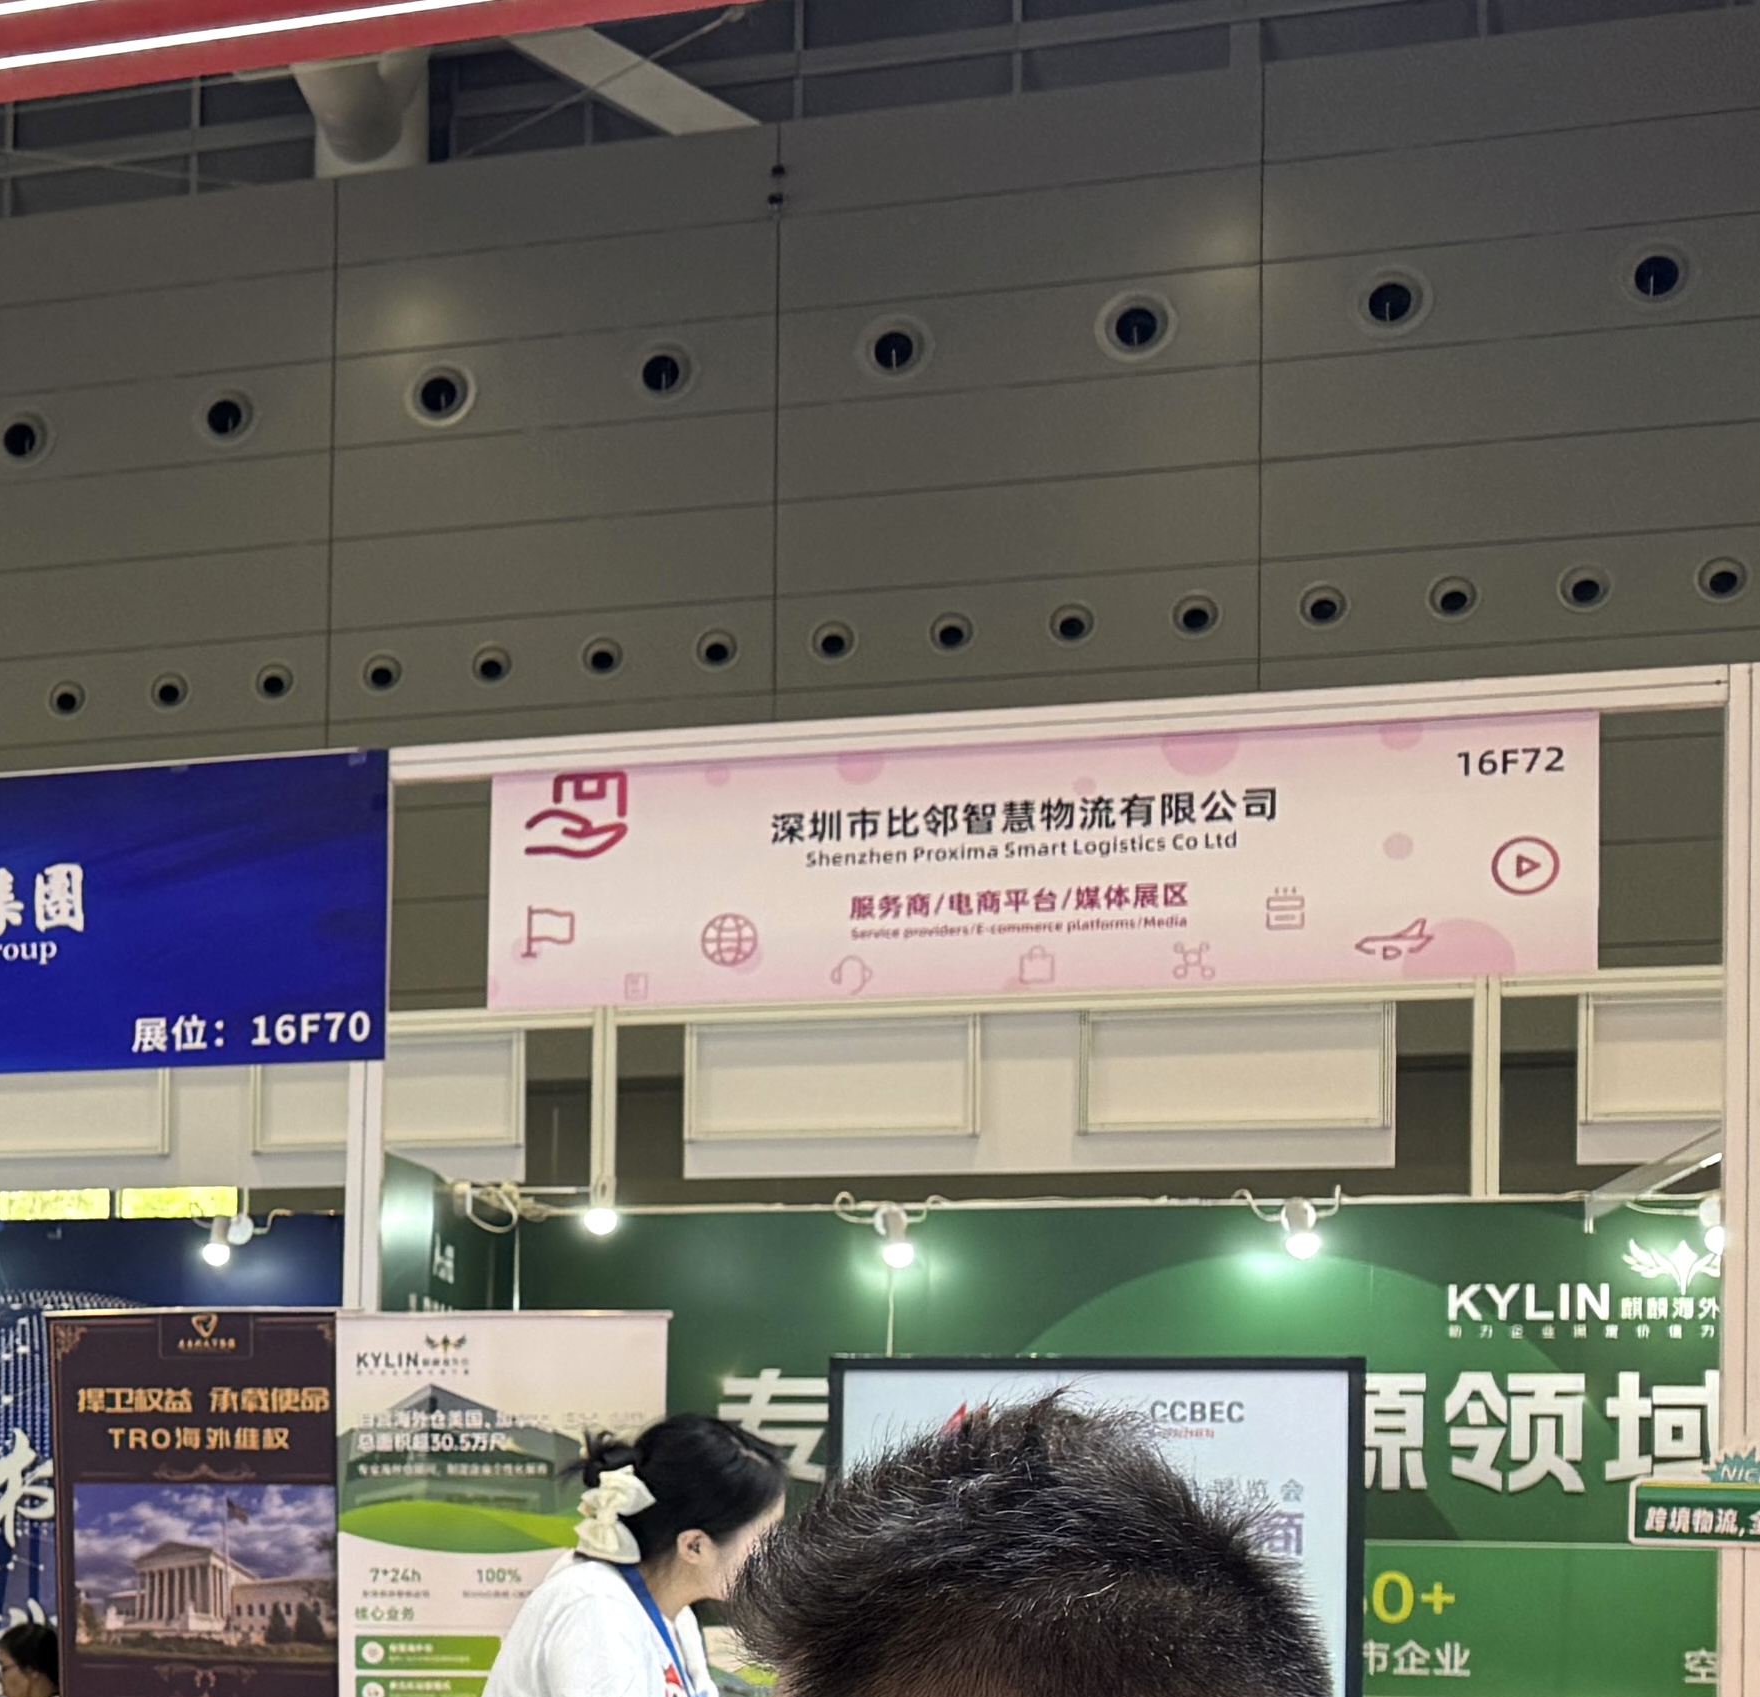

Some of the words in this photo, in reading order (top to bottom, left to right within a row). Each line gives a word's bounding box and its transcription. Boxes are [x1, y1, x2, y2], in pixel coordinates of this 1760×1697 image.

[1457, 746, 1566, 777] 16F72
[770, 786, 1278, 844] 深圳市比邻智慧物流有限公司
[805, 849, 908, 868] Shenzhen
[912, 845, 999, 863] Proxima
[1004, 841, 1068, 859] Smart
[1073, 835, 1166, 859] Logistics
[1172, 834, 1198, 850] Co
[1204, 831, 1237, 849] Ltd
[850, 881, 1189, 920] 服务商/电商平台/媒体展区
[1447, 1282, 1611, 1322] KYLIN
[356, 1352, 420, 1369] KYLIN
[1150, 1400, 1245, 1424] CCBEC
